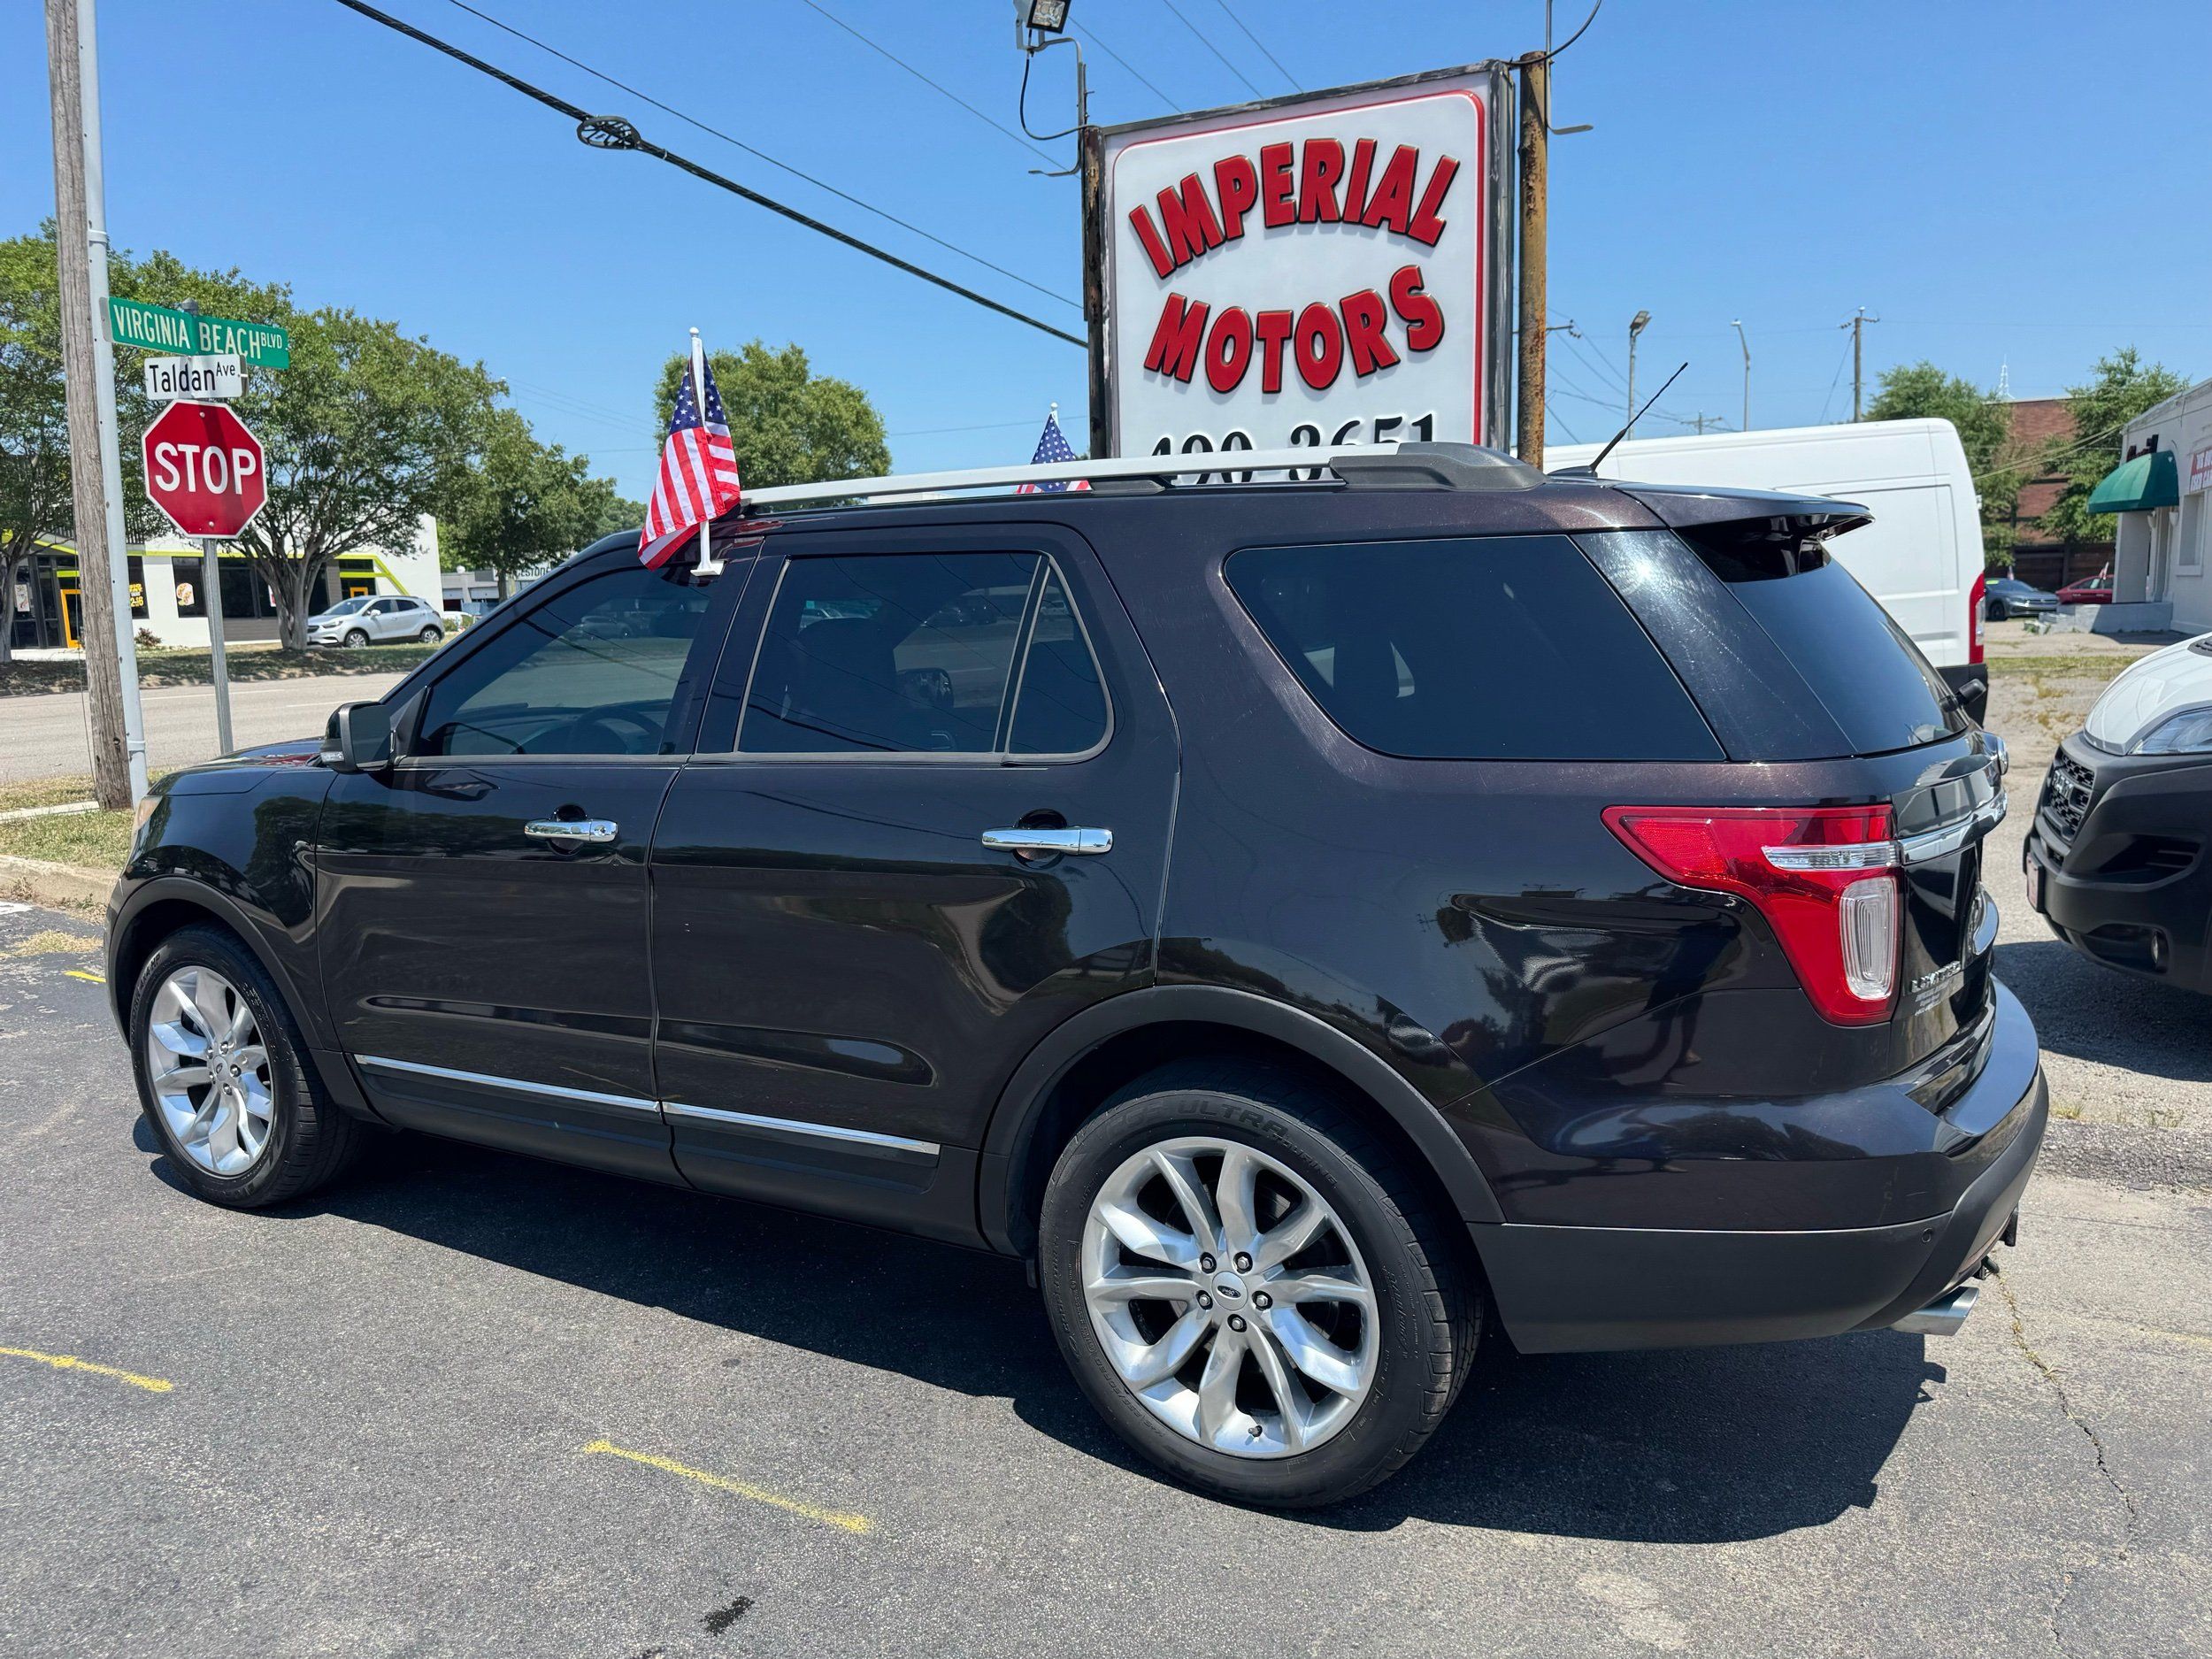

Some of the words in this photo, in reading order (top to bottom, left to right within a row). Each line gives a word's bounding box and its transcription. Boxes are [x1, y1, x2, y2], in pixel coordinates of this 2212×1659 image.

[1128, 137, 1461, 280] IMPERIAL
[113, 304, 191, 349] VIRGINIA
[198, 321, 261, 359] BEACH
[260, 334, 283, 349] BLVD
[1143, 265, 1446, 394] MOTORS
[149, 364, 216, 393] Taldan
[216, 361, 236, 377] Ave
[155, 442, 257, 495] STOP
[1177, 1099, 1289, 1137] ULTRA
